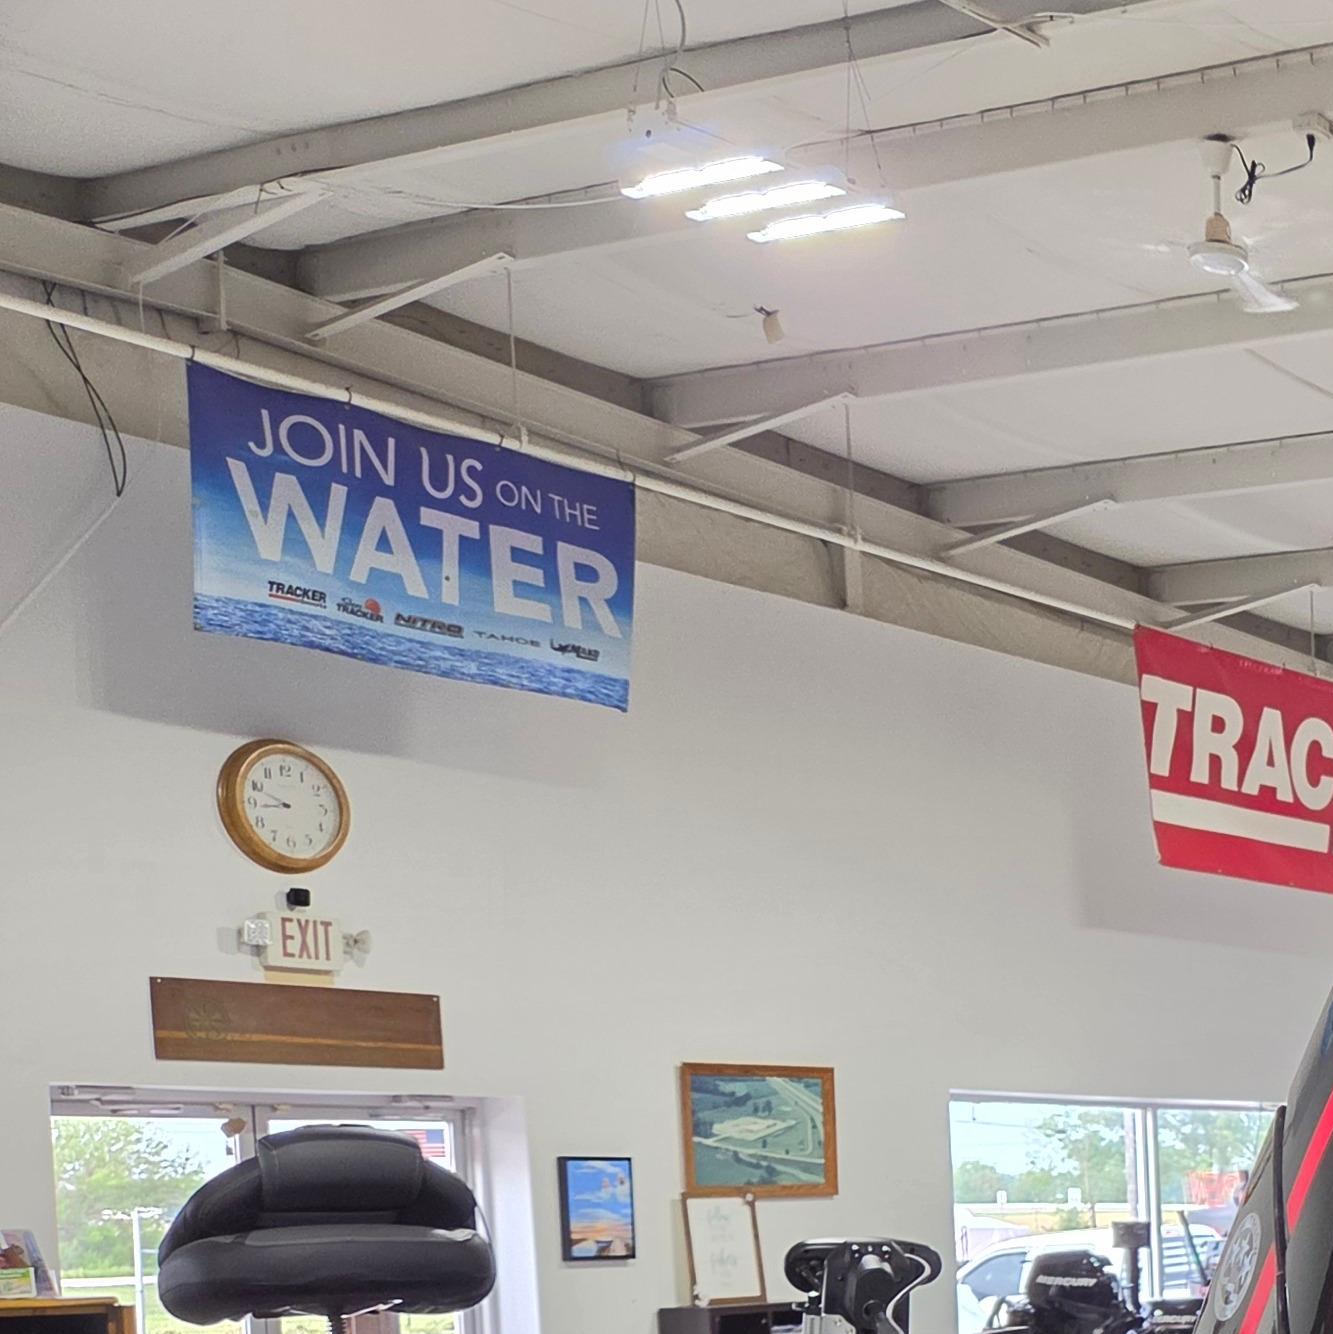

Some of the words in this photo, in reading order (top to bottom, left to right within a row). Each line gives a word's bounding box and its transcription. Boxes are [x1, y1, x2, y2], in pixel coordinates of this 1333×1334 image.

[248, 409, 396, 486] JOIN
[420, 447, 484, 508] US
[496, 480, 542, 514] ON
[548, 492, 601, 530] THE
[225, 457, 624, 639] WATER
[267, 580, 327, 603] TRACKER
[336, 603, 384, 624] TRACKER
[394, 613, 464, 637] NITRO
[473, 630, 542, 647] TAHOE
[280, 916, 333, 961] EXIT
